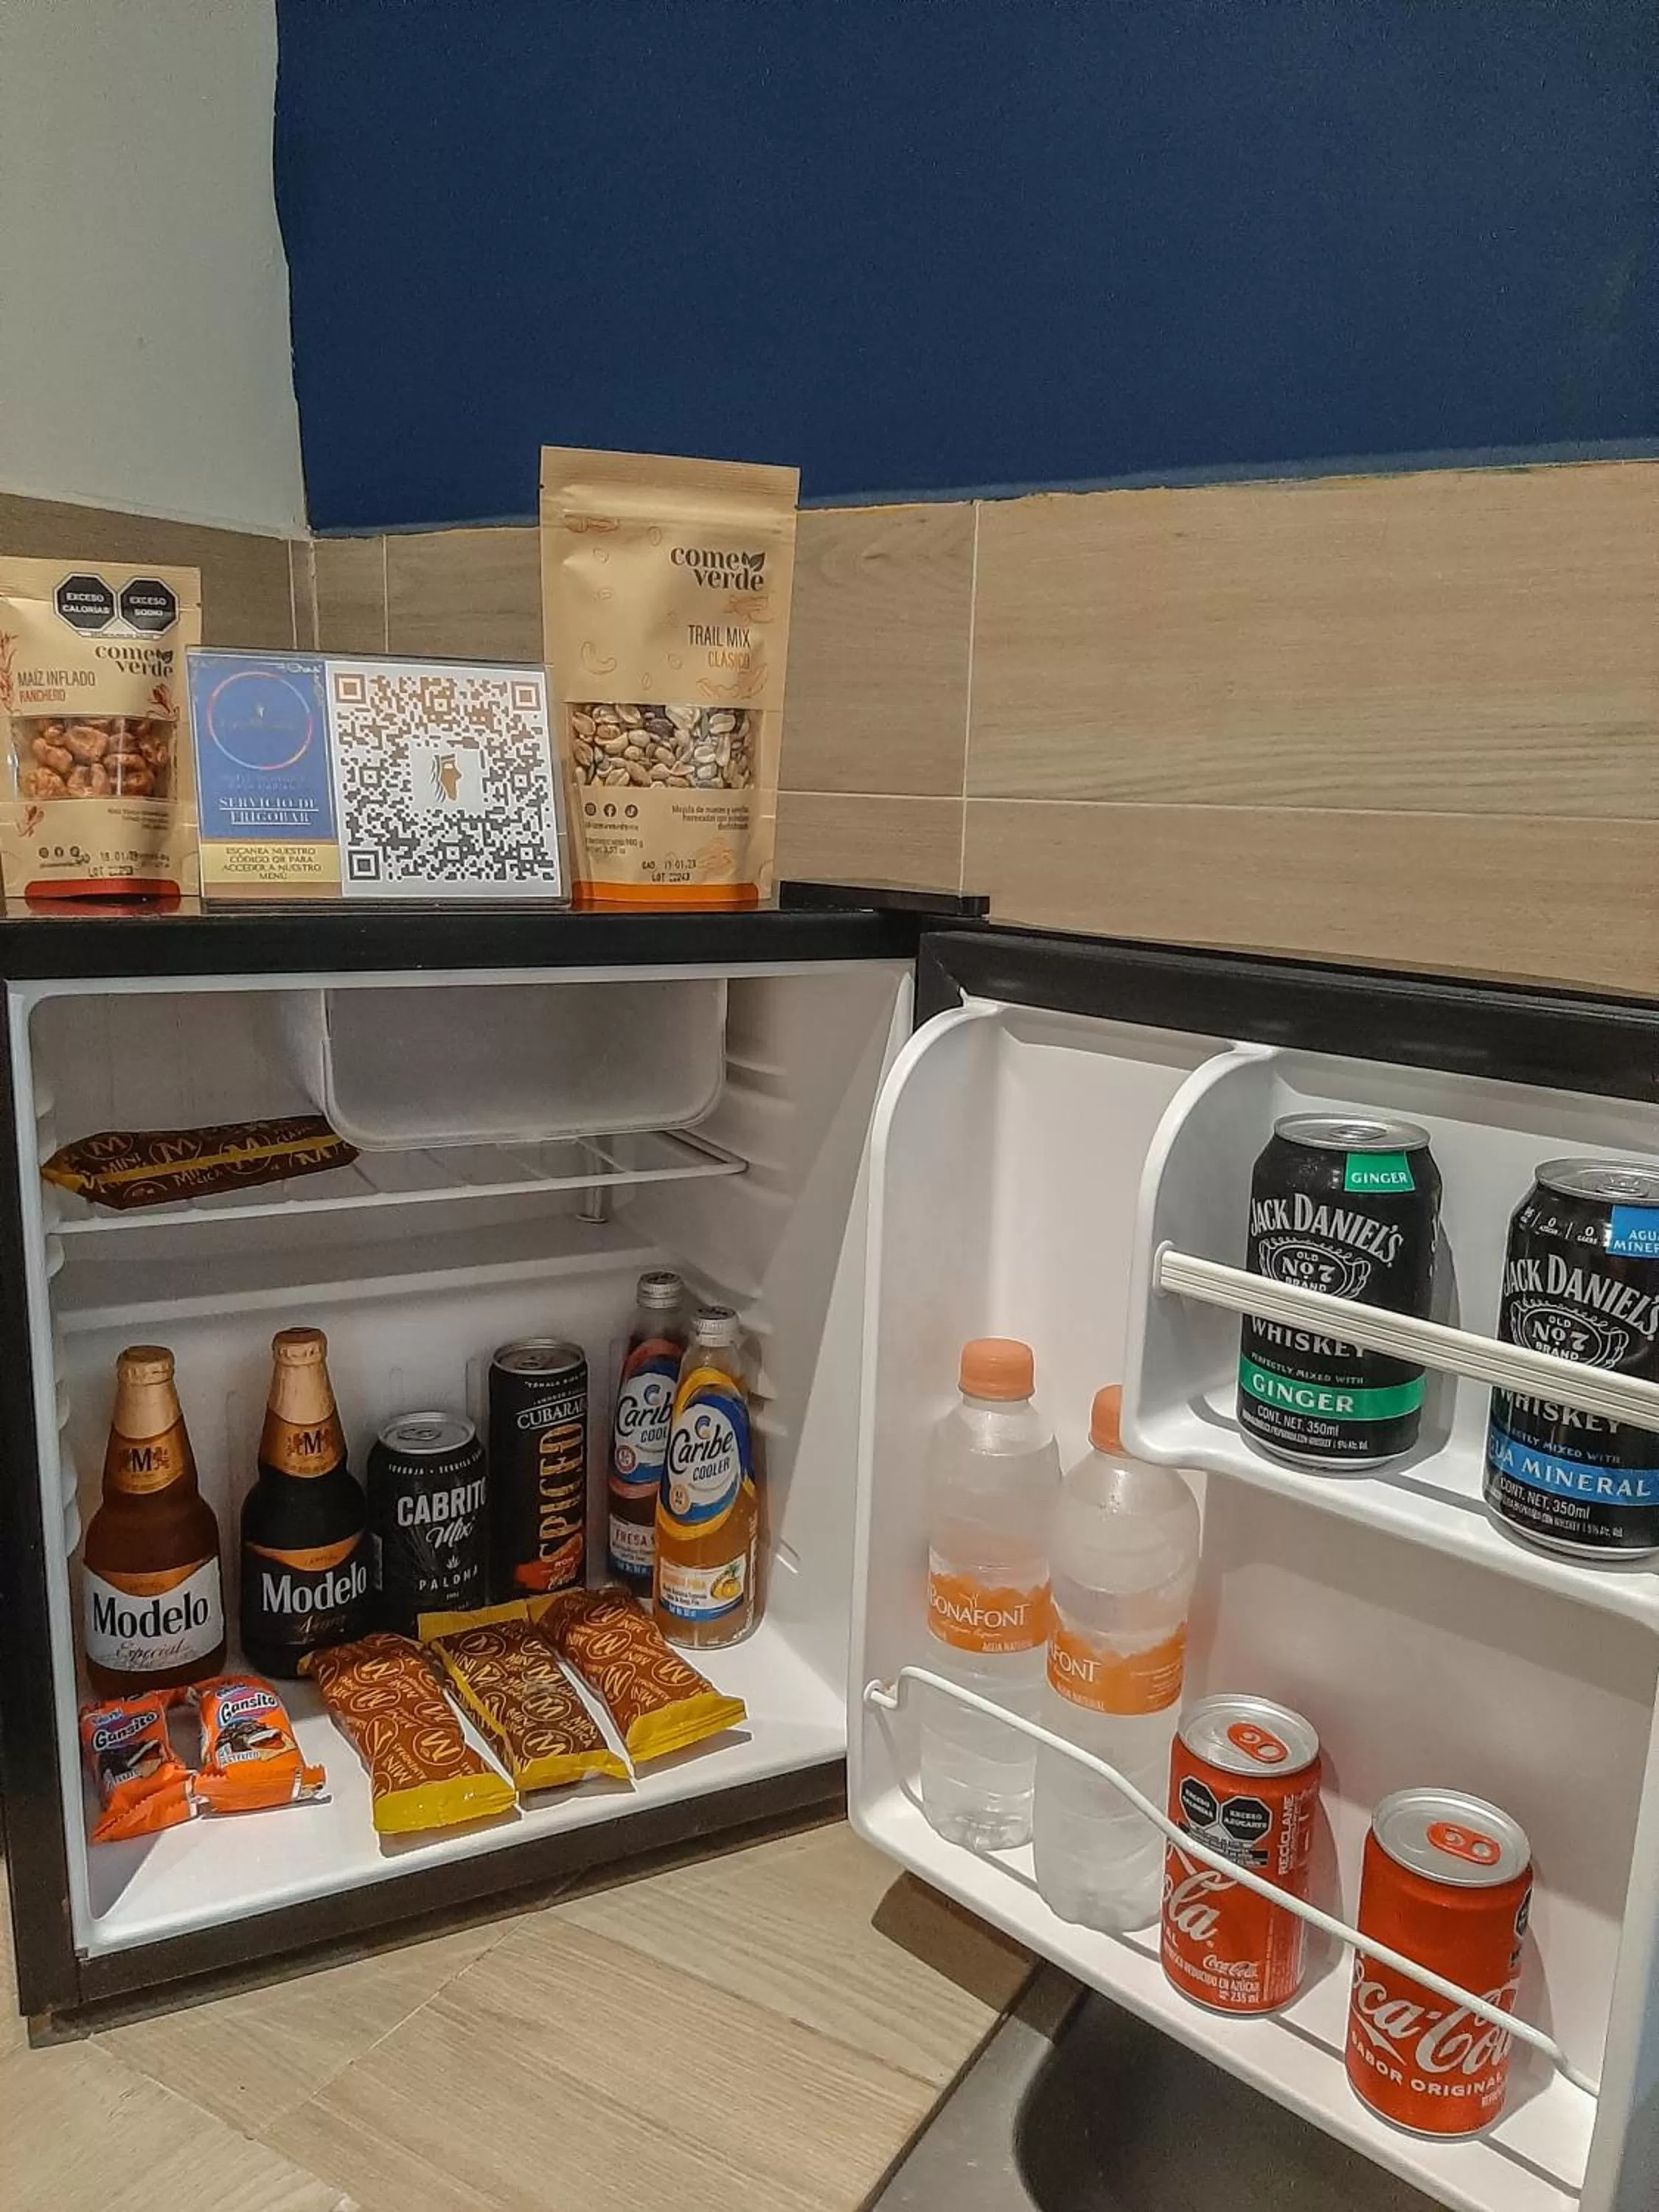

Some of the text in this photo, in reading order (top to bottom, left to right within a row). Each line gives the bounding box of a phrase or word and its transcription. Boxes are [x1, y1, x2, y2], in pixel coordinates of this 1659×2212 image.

[670, 546, 739, 571] come
[693, 568, 764, 591] verde
[66, 592, 105, 602] EXCESO
[129, 596, 167, 605] EXCESO
[134, 608, 163, 616] SODIO
[688, 625, 751, 649] TRAIL MIX
[95, 644, 155, 661] come
[46, 670, 96, 687] INFLADO
[116, 660, 173, 678] verde
[19, 689, 66, 703] RANCHERO
[219, 796, 293, 808] SERVICIO
[231, 810, 309, 822] FRIGOBAR
[223, 863, 265, 872] ACCEDER
[1351, 1171, 1408, 1183] GINGER
[1251, 1192, 1404, 1263] JACK DANIEL'S
[1629, 1229, 1659, 1241] AGU
[1296, 1251, 1319, 1262] OLD
[1503, 1255, 1544, 1298] JACK
[1548, 1314, 1572, 1327] OLD
[1251, 1315, 1365, 1358] WHISKEY
[1535, 1341, 1579, 1361] BRAND
[1251, 1352, 1364, 1385] PERFECTLY MIXED WITH
[1253, 1373, 1354, 1413] GINGER
[616, 1391, 674, 1437] Carib
[1500, 1388, 1623, 1434] WHISKEY
[640, 1425, 668, 1443] COOL
[1306, 1420, 1340, 1437] 350ml
[669, 1423, 734, 1475] Caribe
[1543, 1441, 1582, 1458] MIXED
[1587, 1451, 1621, 1464] WITH
[692, 1456, 731, 1482] COOLER
[1521, 1456, 1652, 1498] MINERAL
[538, 1423, 585, 1563] SPICED
[1552, 1498, 1591, 1520] 350ml
[262, 1561, 367, 1615] Modelo
[92, 1591, 209, 1639] Modelo
[927, 1582, 1032, 1629] BONAFONT
[221, 1693, 276, 1724] Gansito
[96, 1713, 156, 1749] Gansito
[1229, 1809, 1263, 1820] EXCESO
[1411, 2073, 1503, 2097] ORIGINAL
